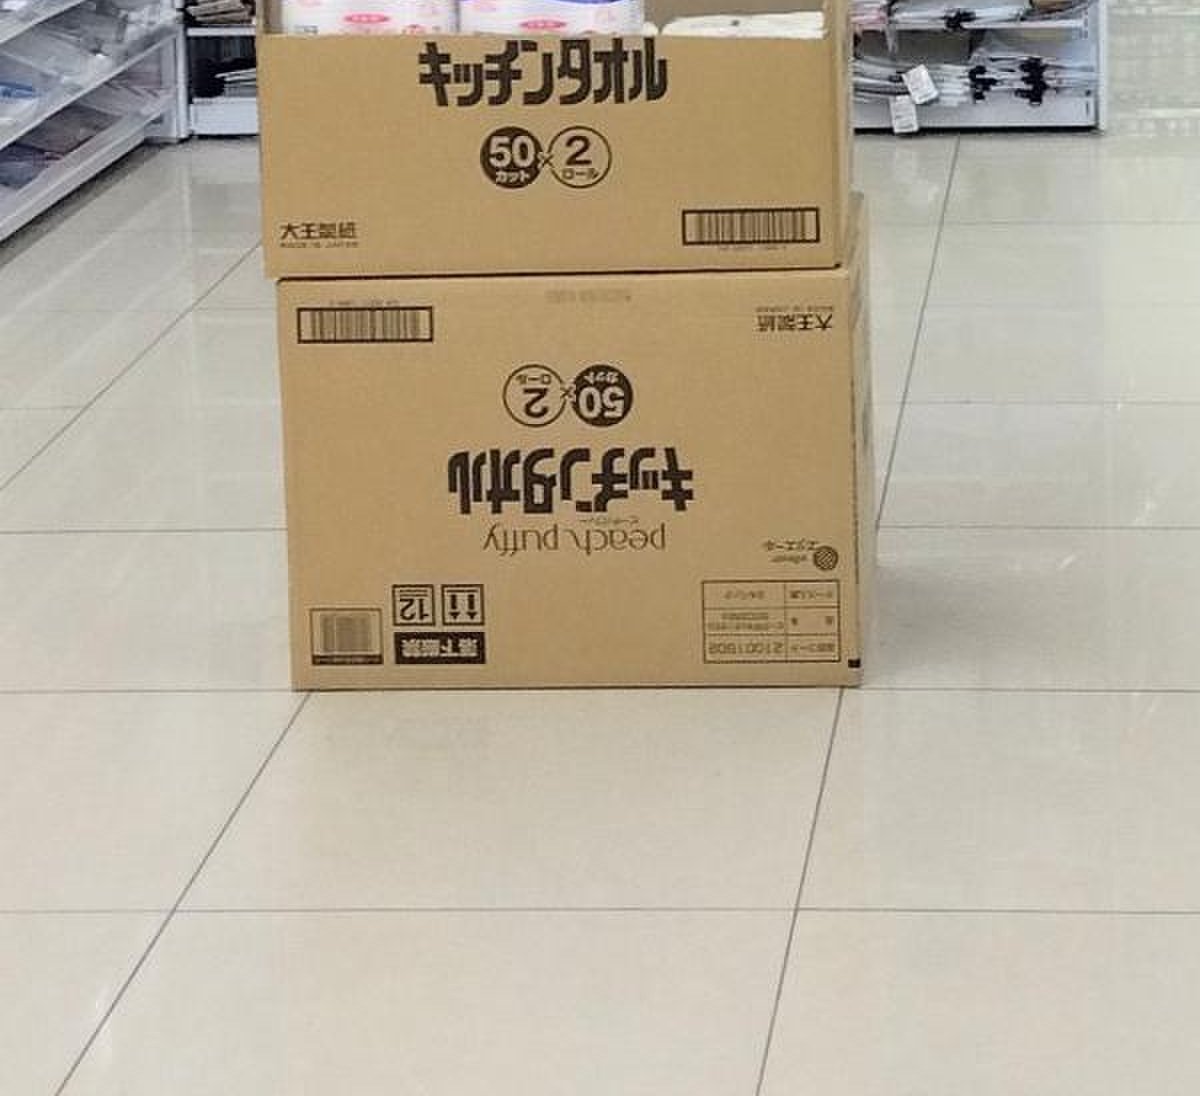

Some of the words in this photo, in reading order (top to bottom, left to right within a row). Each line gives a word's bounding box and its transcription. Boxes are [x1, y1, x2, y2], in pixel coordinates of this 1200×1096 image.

[418, 37, 668, 106] キッチンタオル
[488, 136, 535, 169] 50
[565, 135, 592, 166] 2
[495, 170, 531, 183] カット
[561, 168, 598, 181] ロール
[513, 373, 552, 384] ロール
[581, 370, 620, 383] カット
[522, 386, 549, 418] 2
[578, 385, 626, 417] 50
[448, 447, 694, 515] キッチンタオル
[483, 521, 558, 556] puffy
[563, 523, 667, 556] peach
[400, 598, 430, 621] 12
